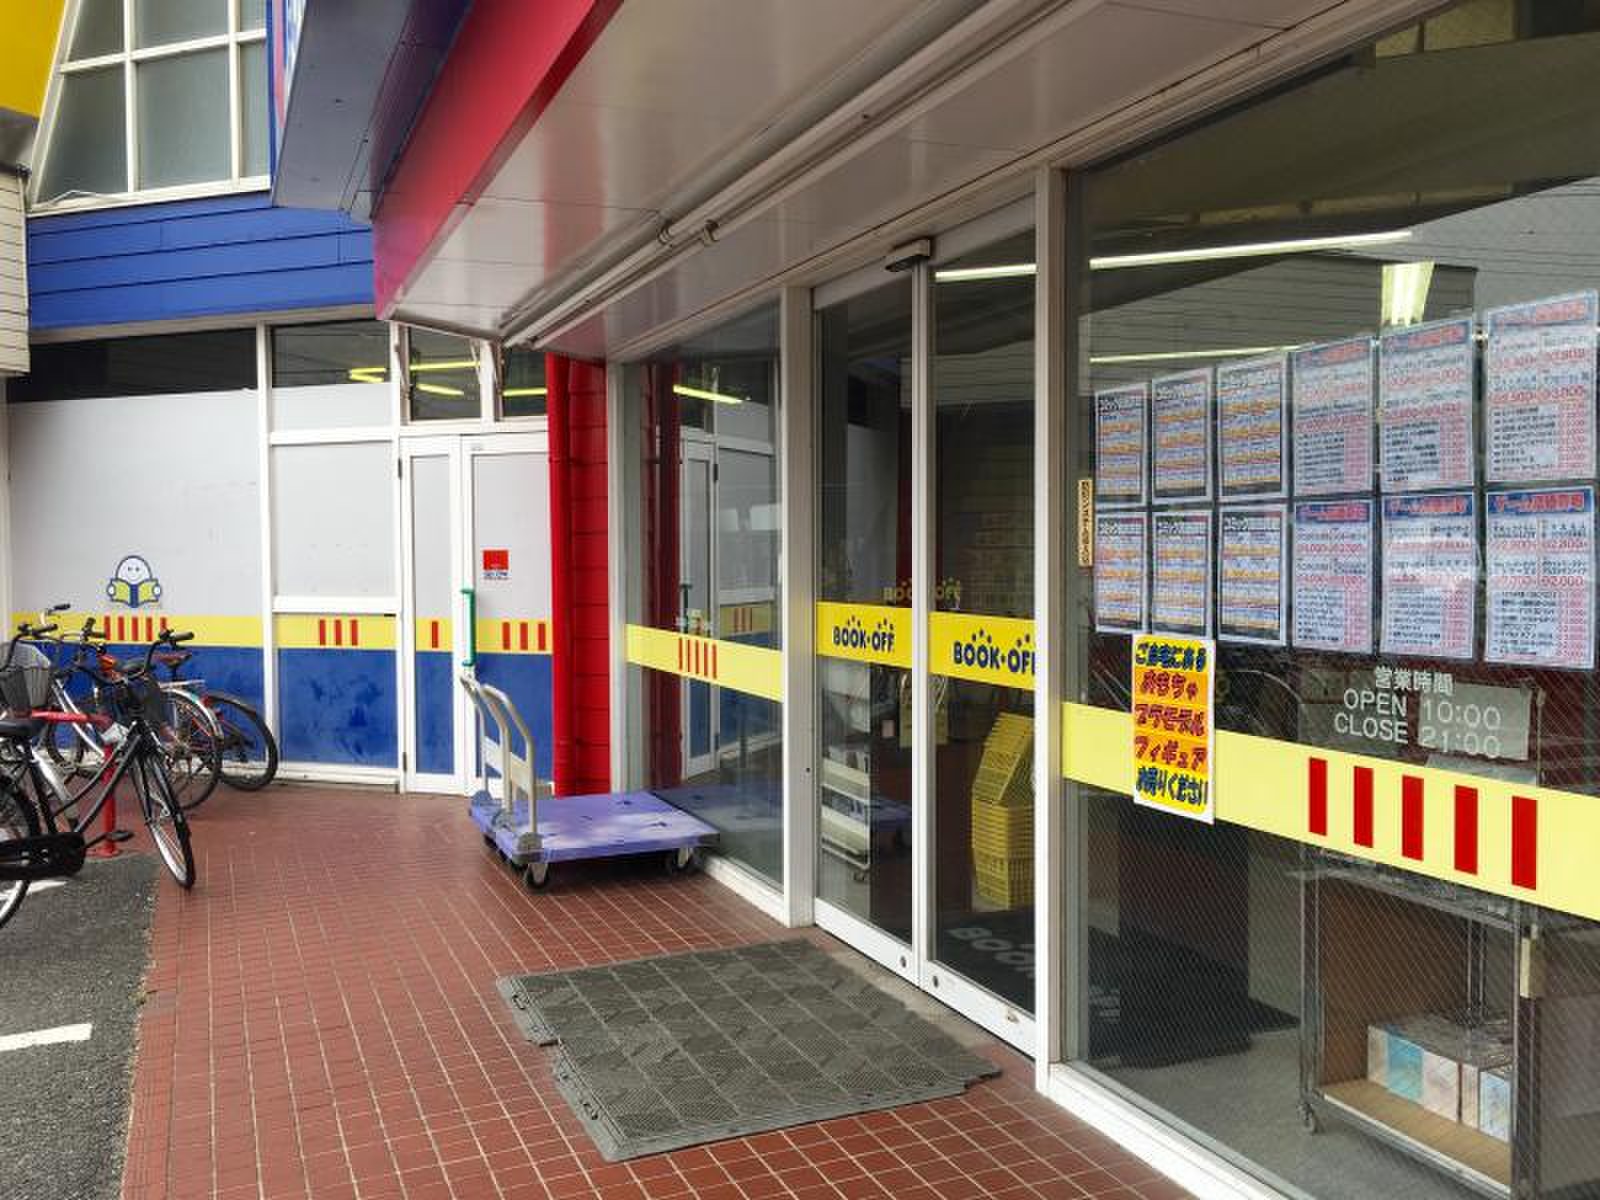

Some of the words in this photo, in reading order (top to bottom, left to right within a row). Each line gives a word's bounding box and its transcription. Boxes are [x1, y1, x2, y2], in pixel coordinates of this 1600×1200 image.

[1141, 669, 1198, 701] おもちゃ
[1375, 665, 1454, 696] 営業時間
[1135, 703, 1205, 737] プラモデル
[1343, 687, 1408, 718] OPEN
[1423, 699, 1501, 731] 10:00
[1334, 711, 1409, 744] CLOSE
[1420, 725, 1501, 758] 21:00
[1135, 735, 1207, 771] フィギュア
